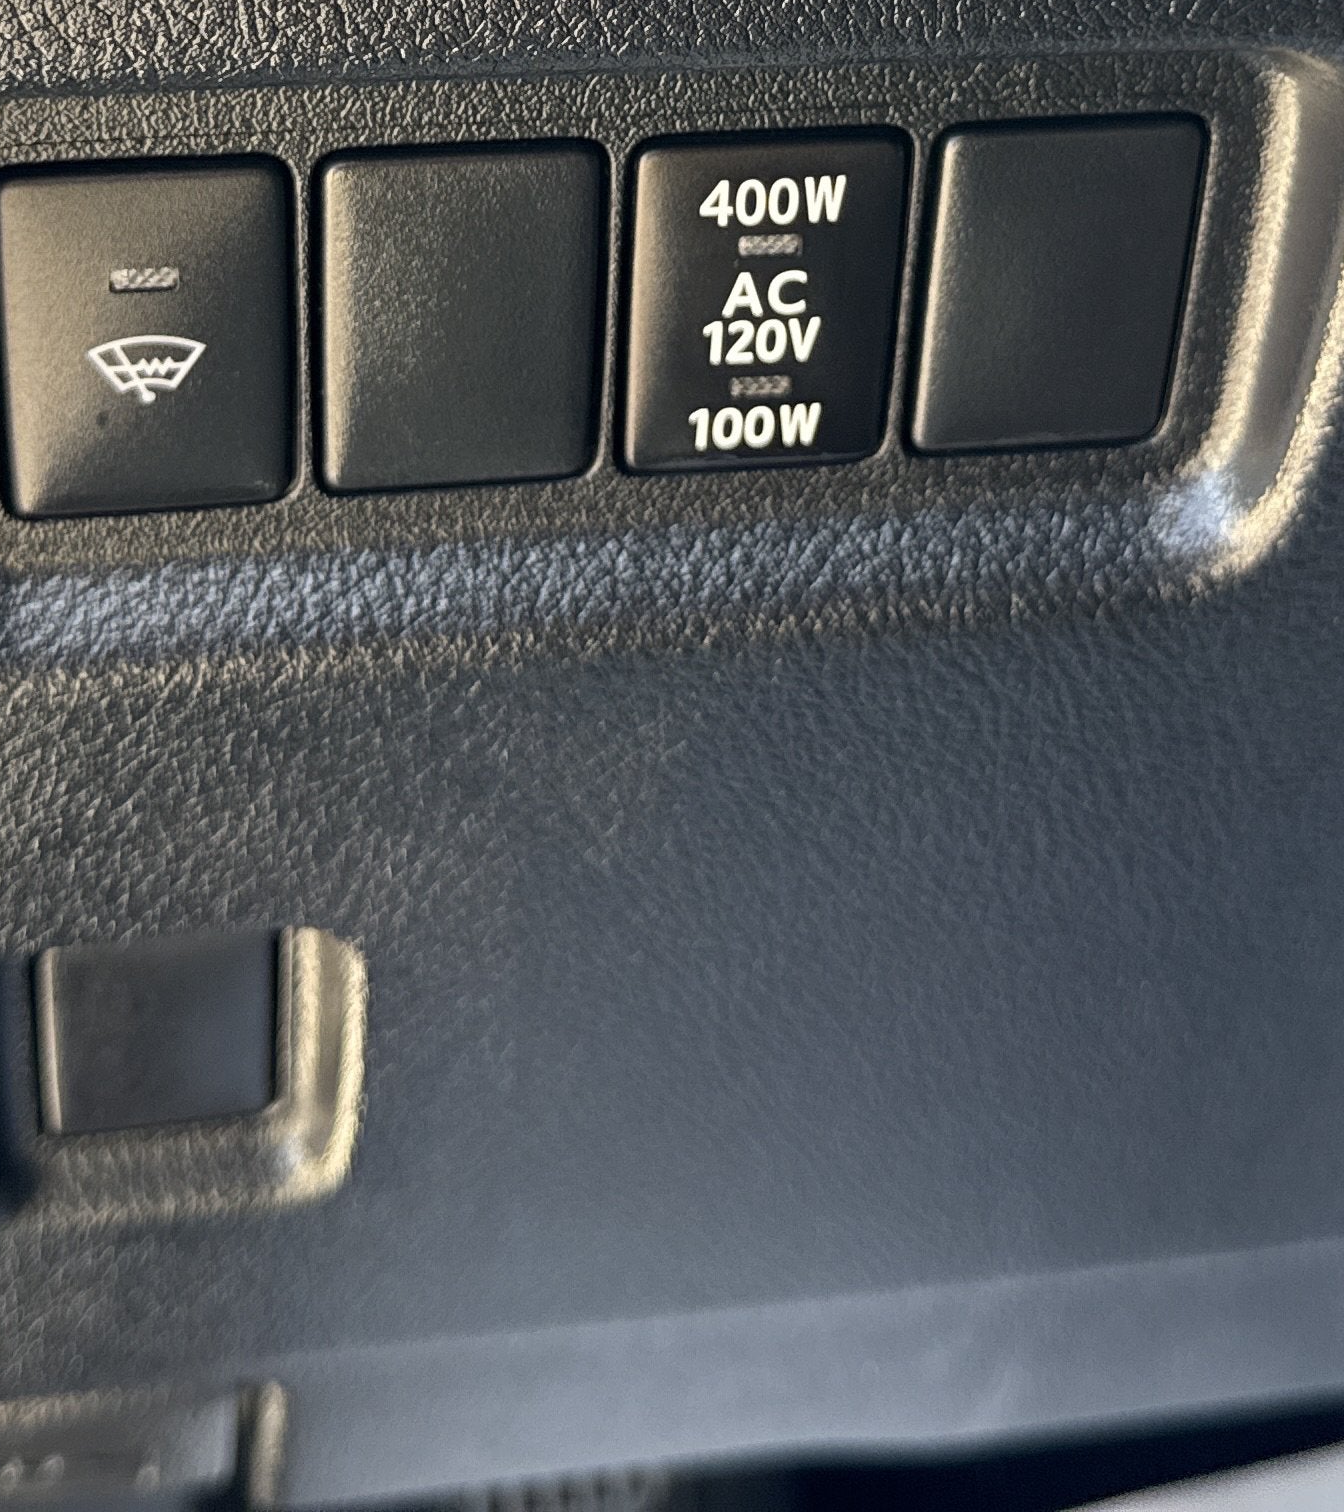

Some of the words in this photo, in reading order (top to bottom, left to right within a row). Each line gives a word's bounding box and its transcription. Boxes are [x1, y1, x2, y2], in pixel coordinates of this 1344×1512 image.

[699, 174, 847, 227] 400W
[722, 269, 808, 318] AC
[702, 316, 821, 366] 120V
[688, 402, 822, 451] 100W
